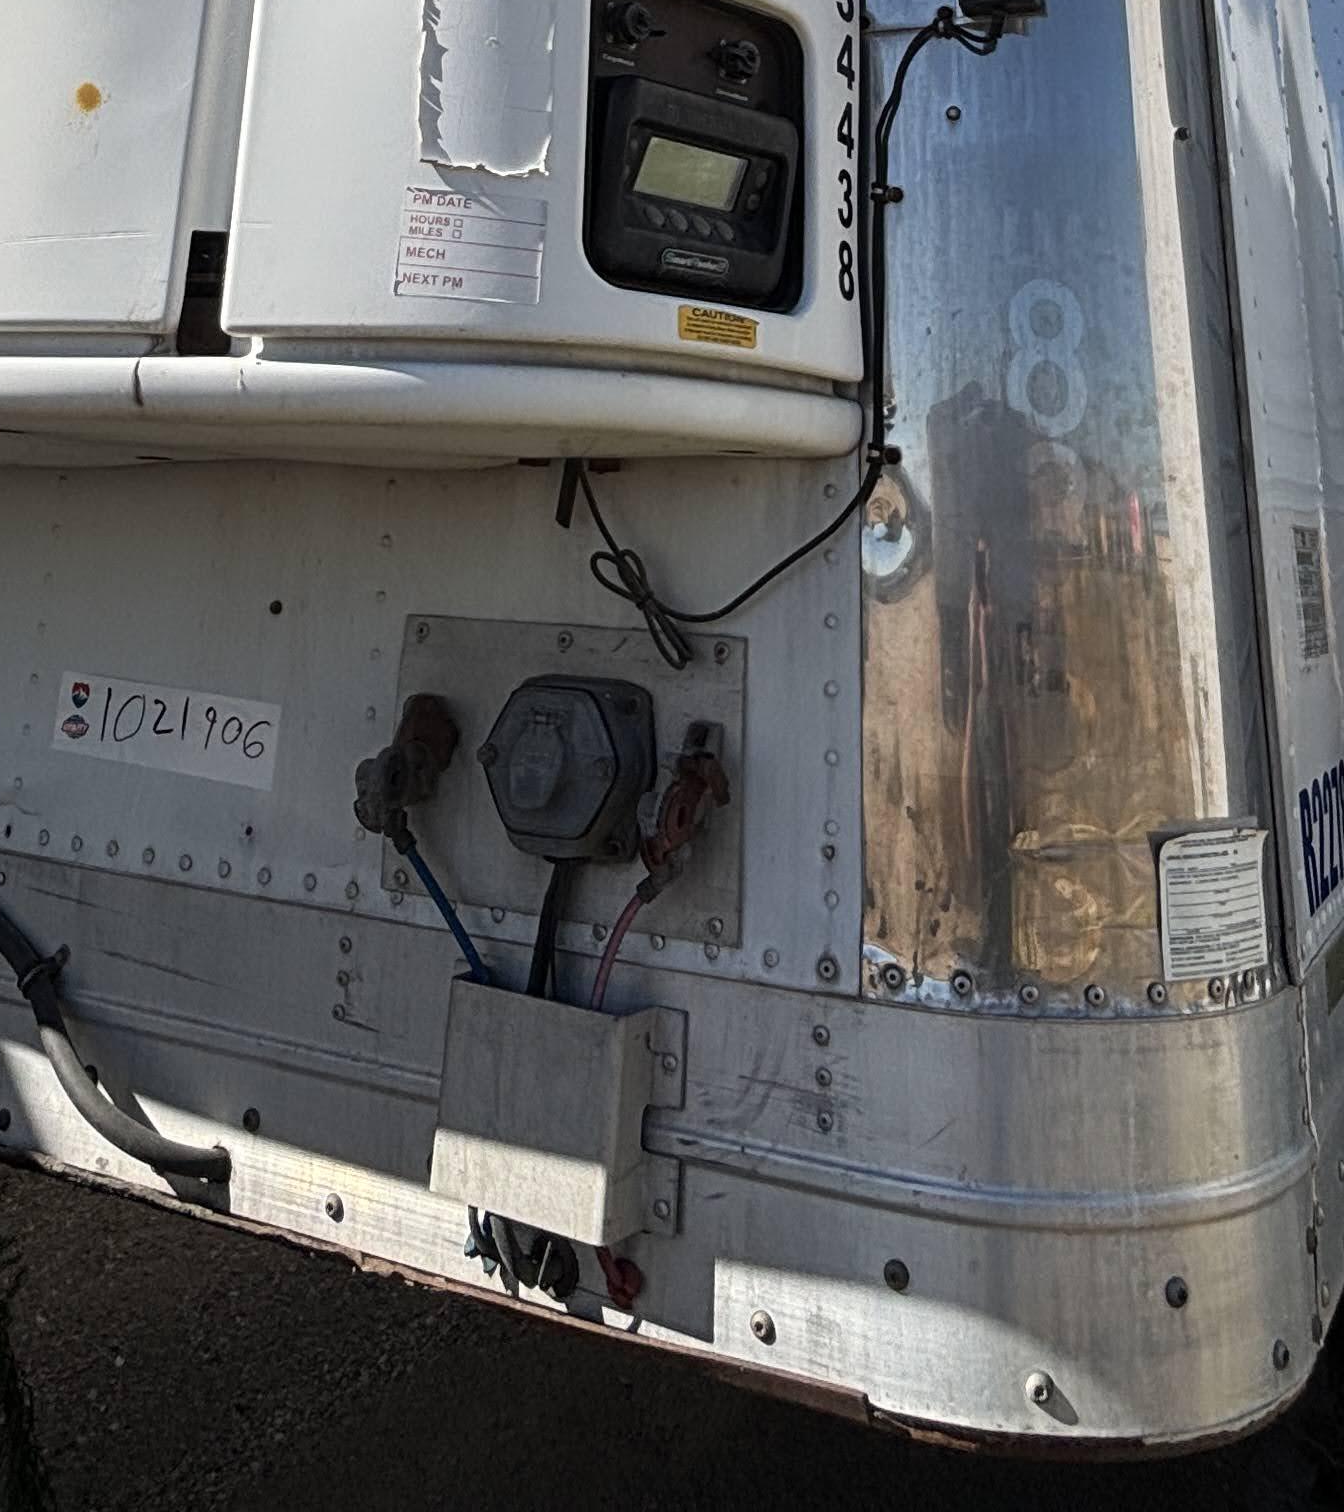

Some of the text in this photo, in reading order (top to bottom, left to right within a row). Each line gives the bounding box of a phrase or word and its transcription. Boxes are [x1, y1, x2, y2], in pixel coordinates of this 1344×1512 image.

[412, 193, 473, 210] PM DATE
[409, 214, 451, 227] HOURS
[408, 225, 443, 238] MILES
[406, 246, 446, 261] MECH
[402, 272, 464, 289] NEXT PM
[100, 686, 271, 759] 1021906
